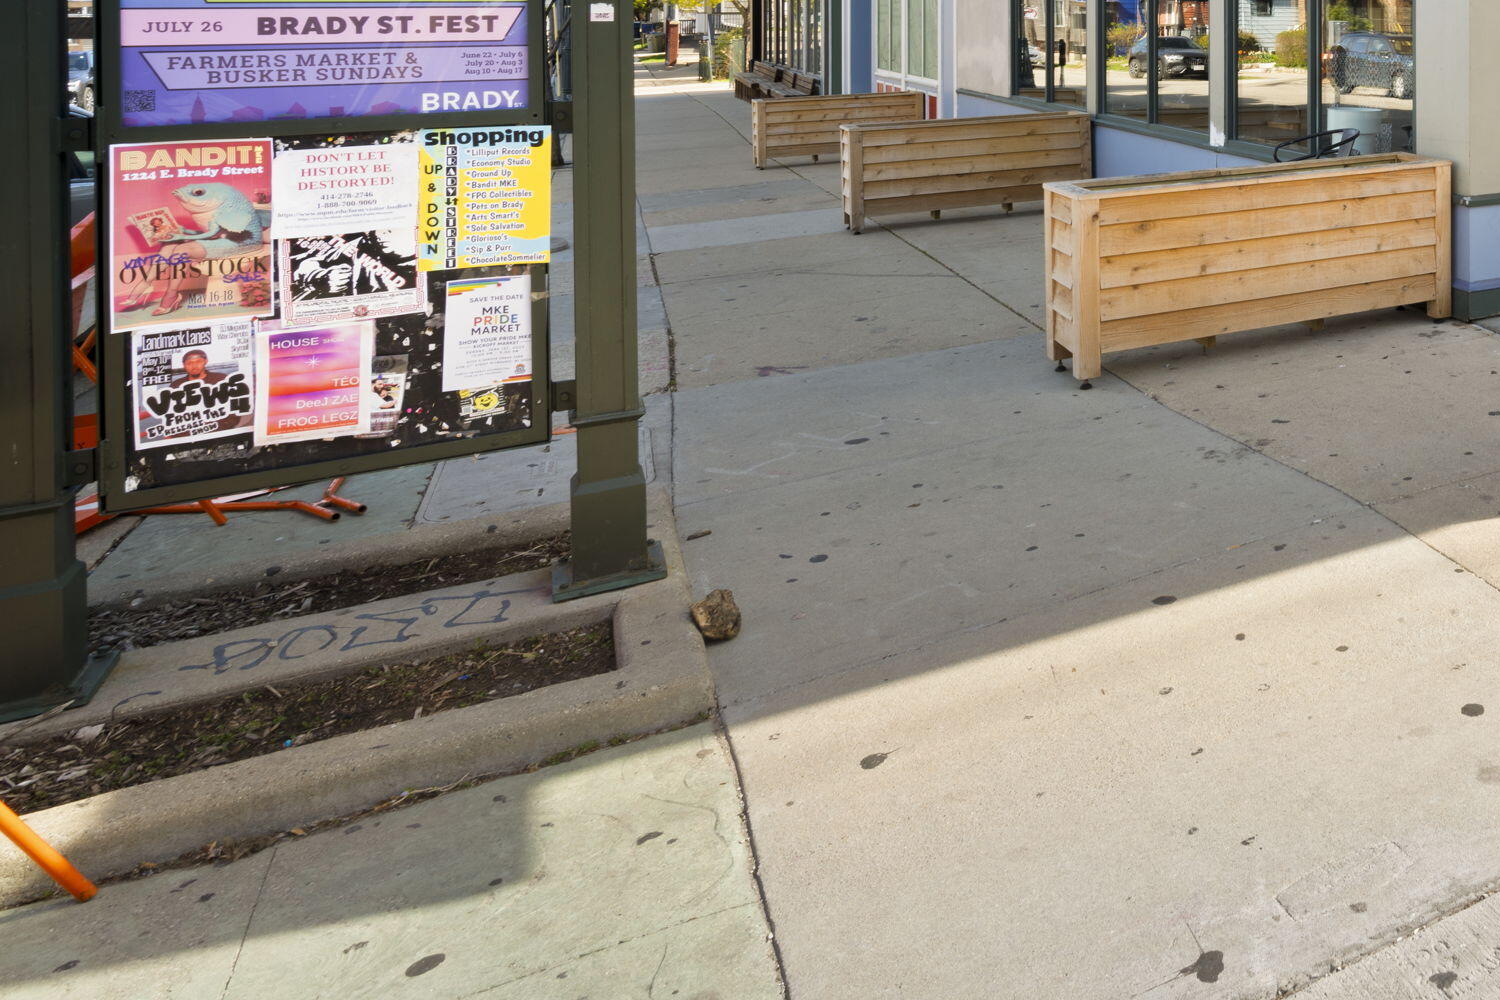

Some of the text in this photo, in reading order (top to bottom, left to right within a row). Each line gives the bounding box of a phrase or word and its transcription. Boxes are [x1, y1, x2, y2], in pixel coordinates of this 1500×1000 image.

[142, 15, 500, 36] JULY 26 BRADY ST. FEST
[499, 51, 516, 59] July
[167, 52, 418, 71] FARMERS MARKET &
[207, 65, 424, 84] BUSKER SUNDAYS
[422, 90, 520, 111] BRADY
[120, 145, 252, 171] BANDIT
[306, 151, 386, 164] DON'T LET
[471, 148, 530, 157] Lilliput Records
[507, 158, 531, 166] Studio
[122, 165, 264, 181] 1224 E. Brady Street
[300, 165, 392, 178] HISTORY BE
[425, 164, 443, 175] UP
[471, 169, 511, 178] Ground Up
[298, 176, 395, 191] DESTORYED!
[427, 183, 437, 193] &
[471, 189, 532, 199] FPG Collectibles
[471, 202, 487, 210] Pets
[502, 201, 524, 209] Brady
[471, 213, 487, 221] Arts
[471, 222, 525, 232] Sole Salvation
[471, 244, 511, 254] Sip & Purr
[124, 252, 192, 269] VINTAGE
[119, 257, 268, 285] OVERSTOCK
[360, 253, 406, 288] WORLD
[223, 272, 265, 283] SALE
[482, 305, 509, 315] MKE
[473, 314, 518, 326] PRIDE
[471, 324, 521, 336] MARKET
[143, 332, 186, 351] Landmark
[187, 330, 211, 345] Lanes
[271, 337, 319, 349] HOUSE
[142, 374, 172, 386] FREE
[146, 374, 250, 416] VIEWS
[166, 397, 251, 427] FROM THE 4
[278, 415, 319, 429] FROG
[148, 425, 165, 438] EP
[191, 422, 219, 436] SHOW
